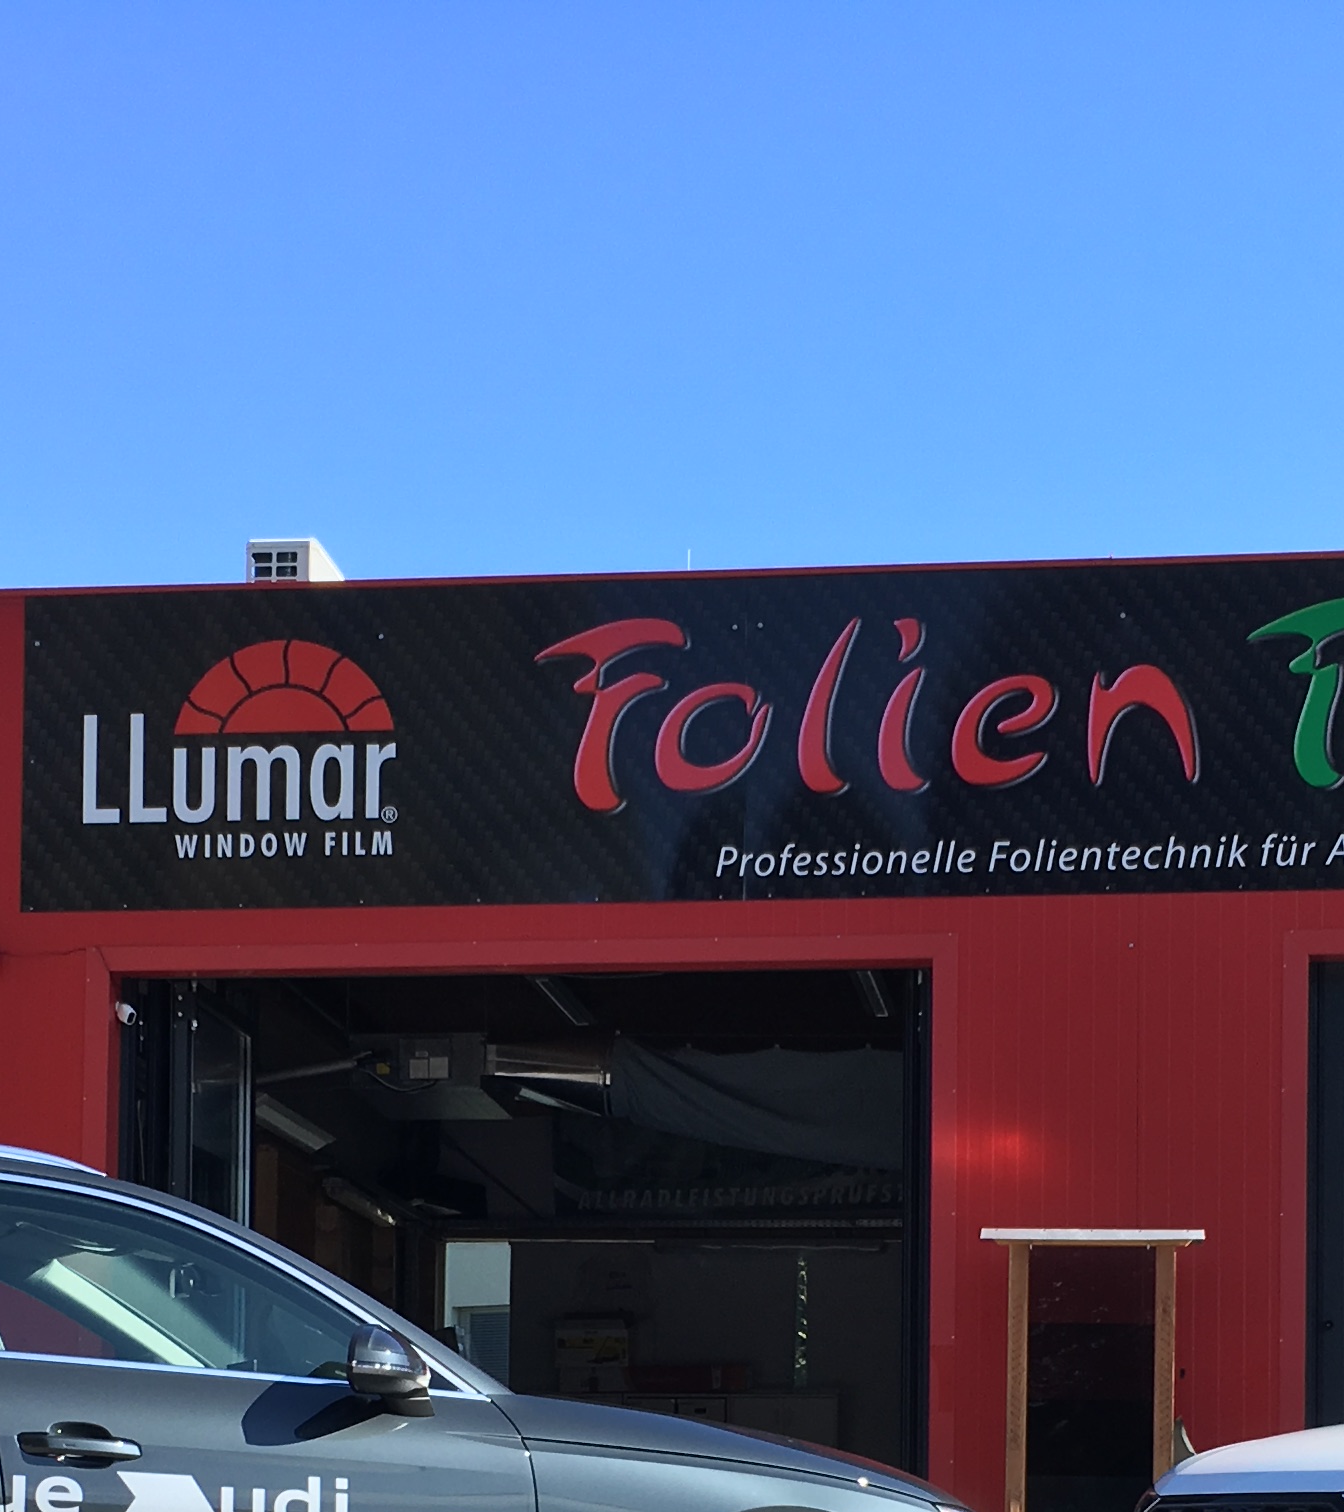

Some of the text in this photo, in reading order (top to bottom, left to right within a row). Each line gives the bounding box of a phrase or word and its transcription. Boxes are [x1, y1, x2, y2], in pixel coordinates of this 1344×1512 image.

[534, 617, 1200, 814] Folien
[174, 829, 394, 859] WINDOW FILM
[715, 840, 975, 878] Professionelle
[988, 833, 1249, 873] Folientechnik
[1260, 833, 1317, 867] für
